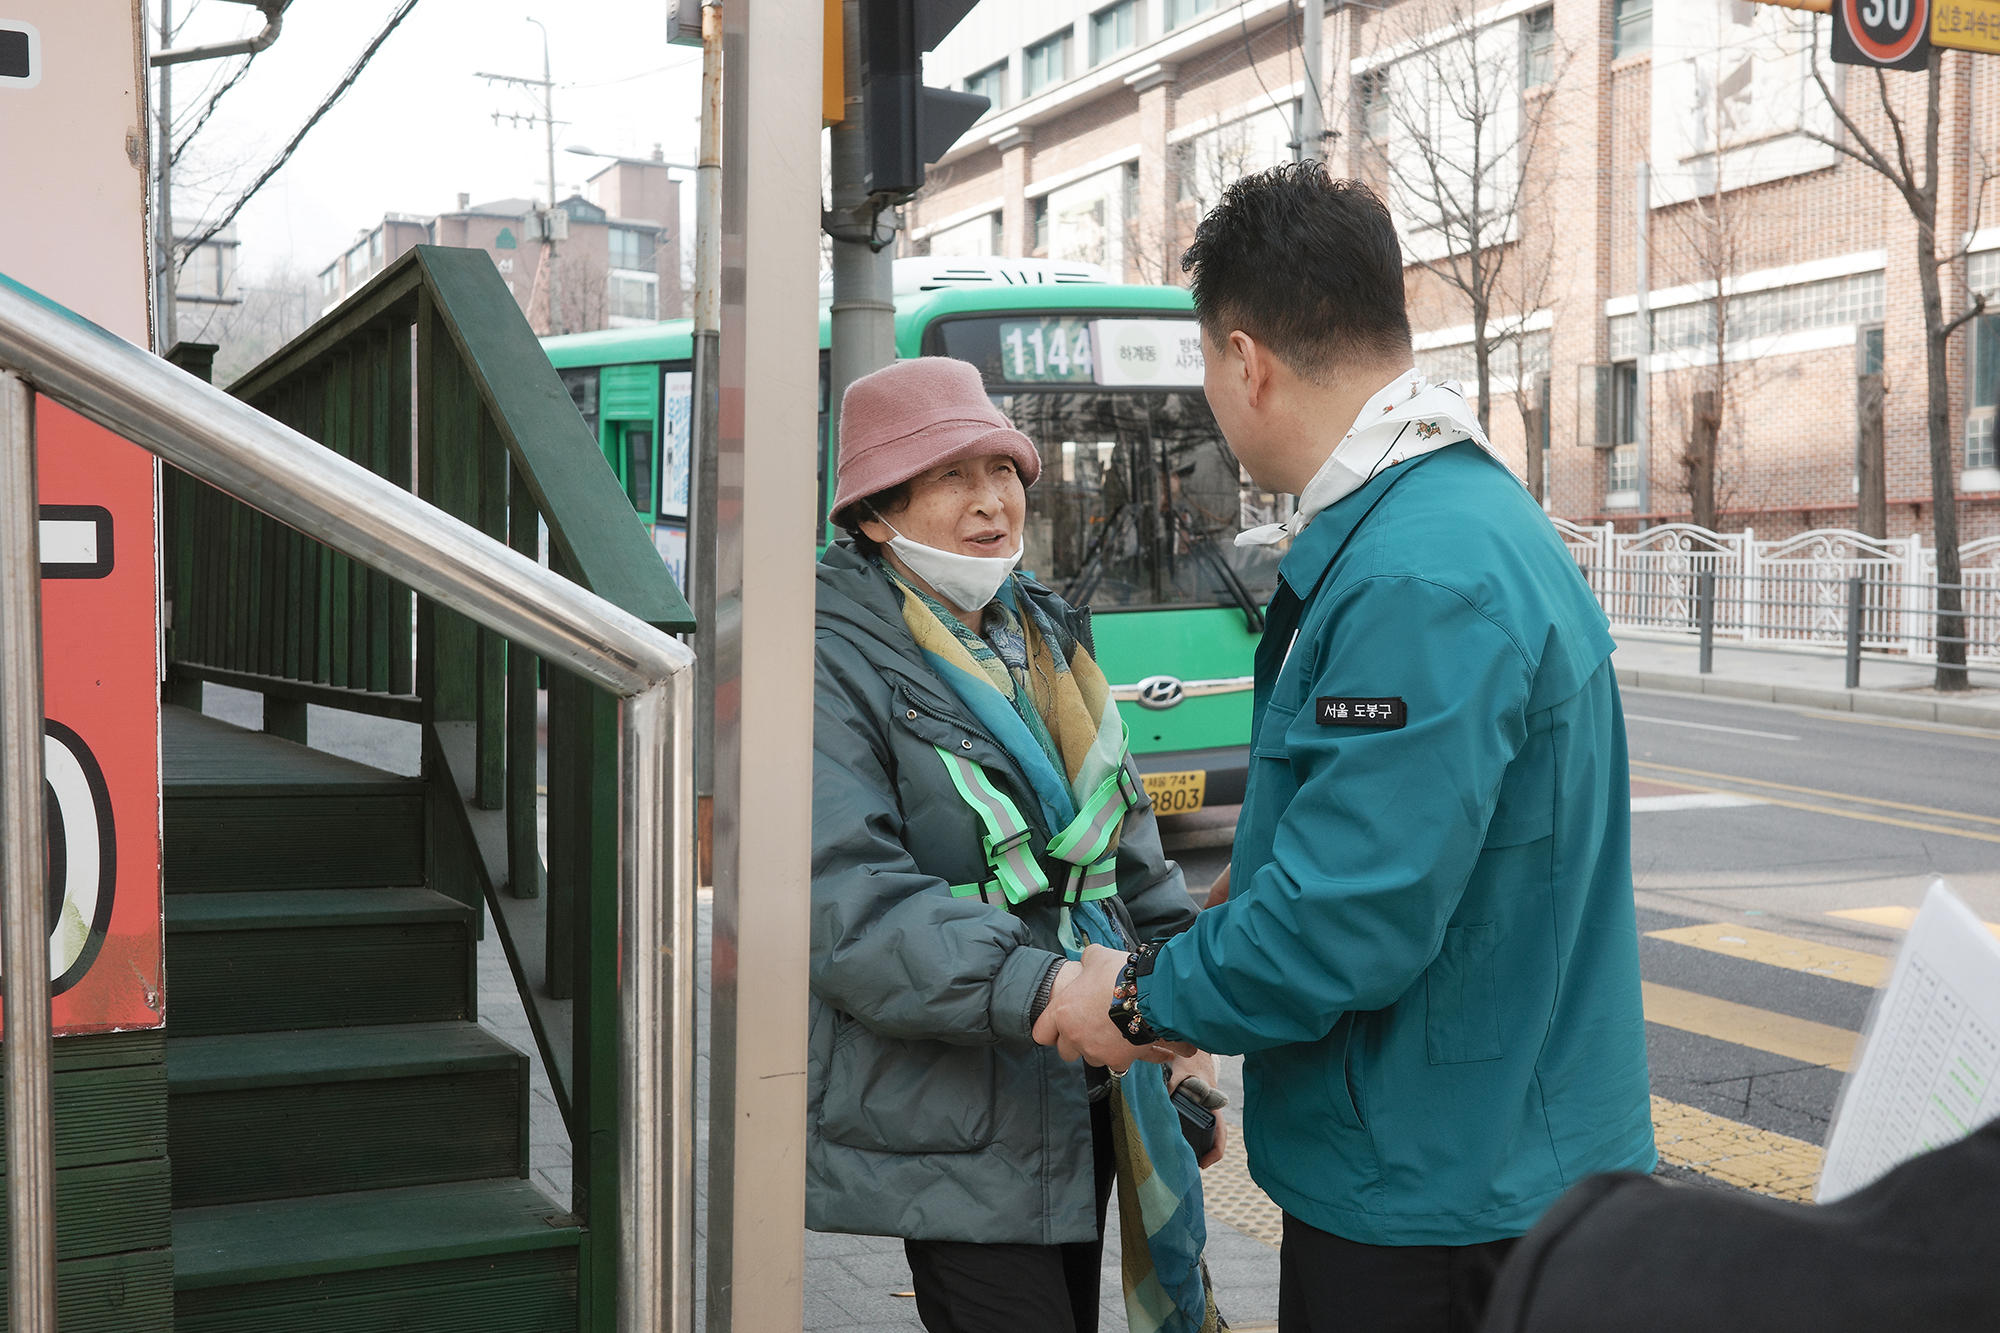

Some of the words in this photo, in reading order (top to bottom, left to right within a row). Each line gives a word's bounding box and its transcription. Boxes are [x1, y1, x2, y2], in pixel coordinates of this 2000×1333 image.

[1006, 327, 1093, 375] 1144
[1119, 345, 1158, 362] 하계동
[1324, 702, 1349, 719] 서울
[1354, 703, 1392, 720] 도봉구
[1170, 775, 1186, 787] 74
